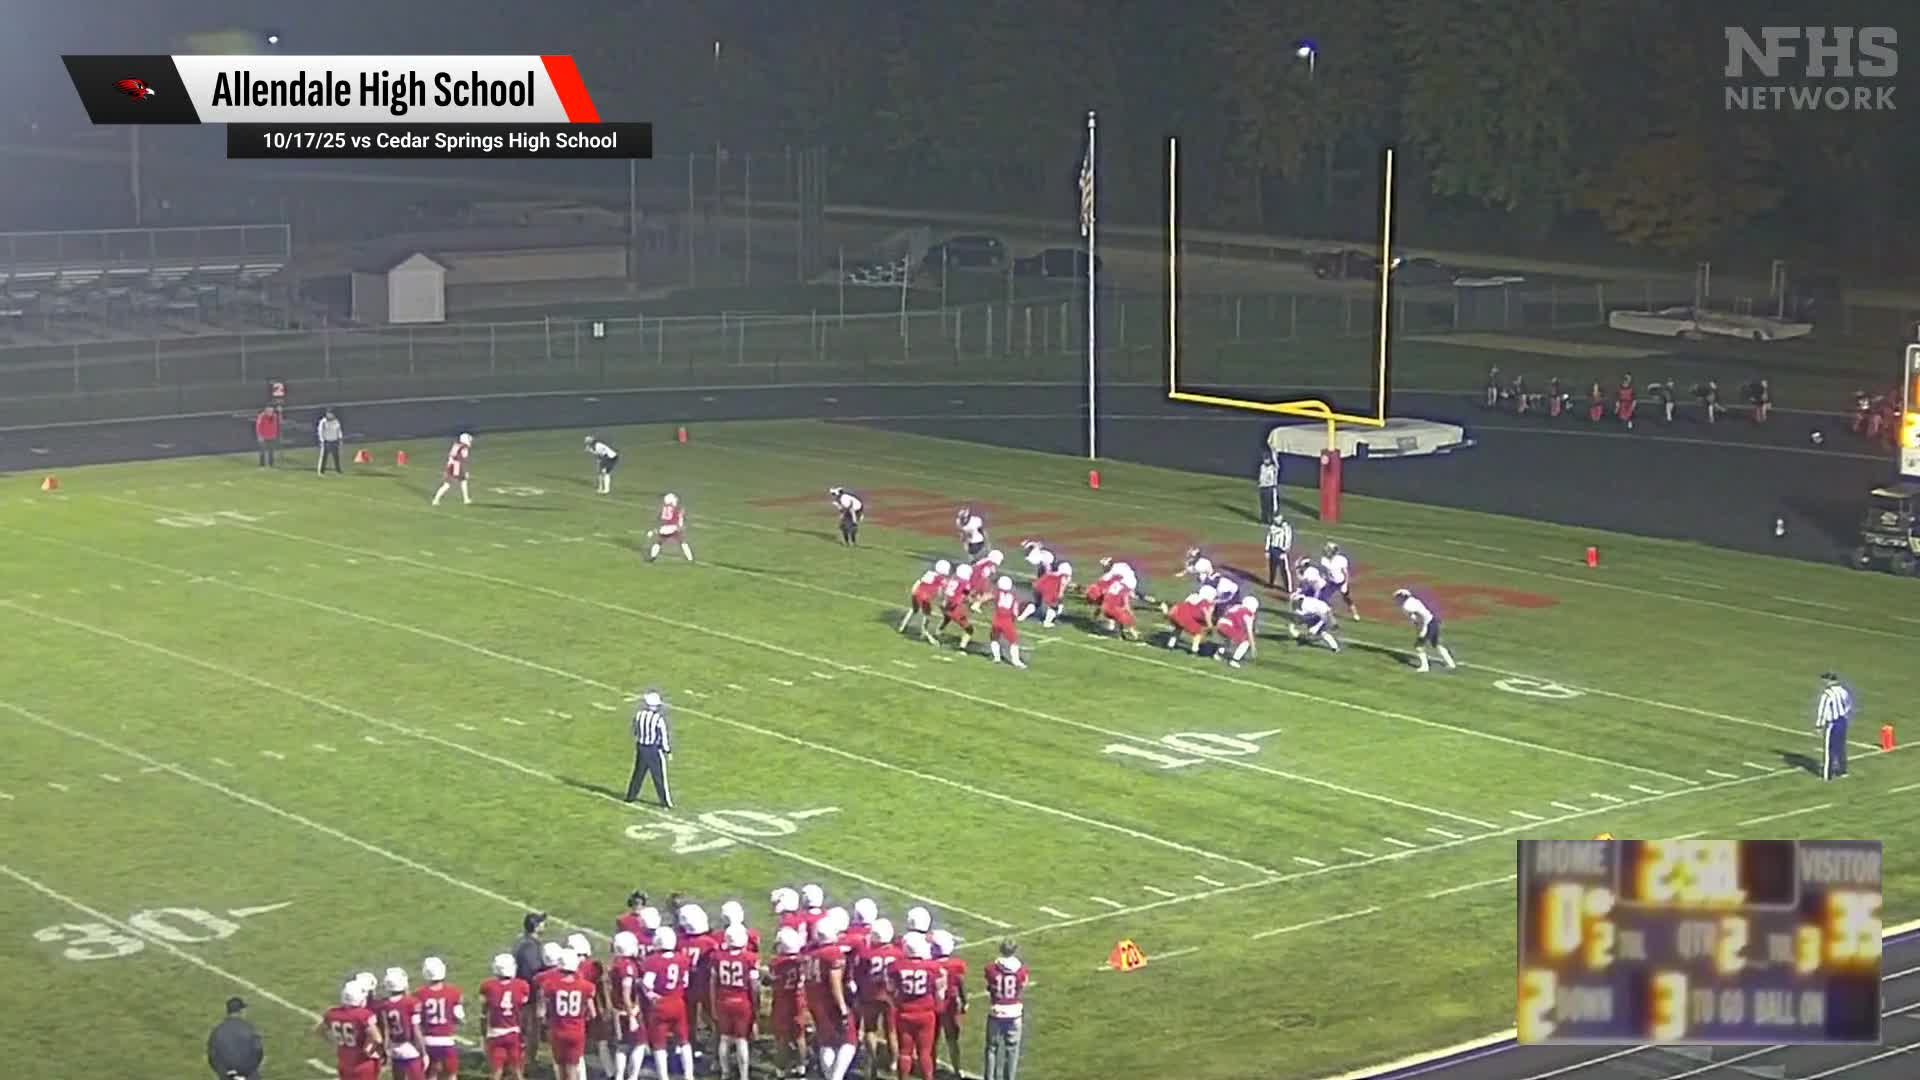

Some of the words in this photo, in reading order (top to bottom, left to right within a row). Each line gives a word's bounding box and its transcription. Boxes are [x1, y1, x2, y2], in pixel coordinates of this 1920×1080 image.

[1102, 732, 1260, 769] 10
[624, 809, 798, 854] 20
[33, 907, 240, 960] 30
[666, 963, 680, 990] 9
[719, 959, 744, 987] 62
[901, 968, 928, 995] 52
[424, 997, 448, 1025] 21
[500, 991, 514, 1017] 4
[556, 989, 582, 1017] 68
